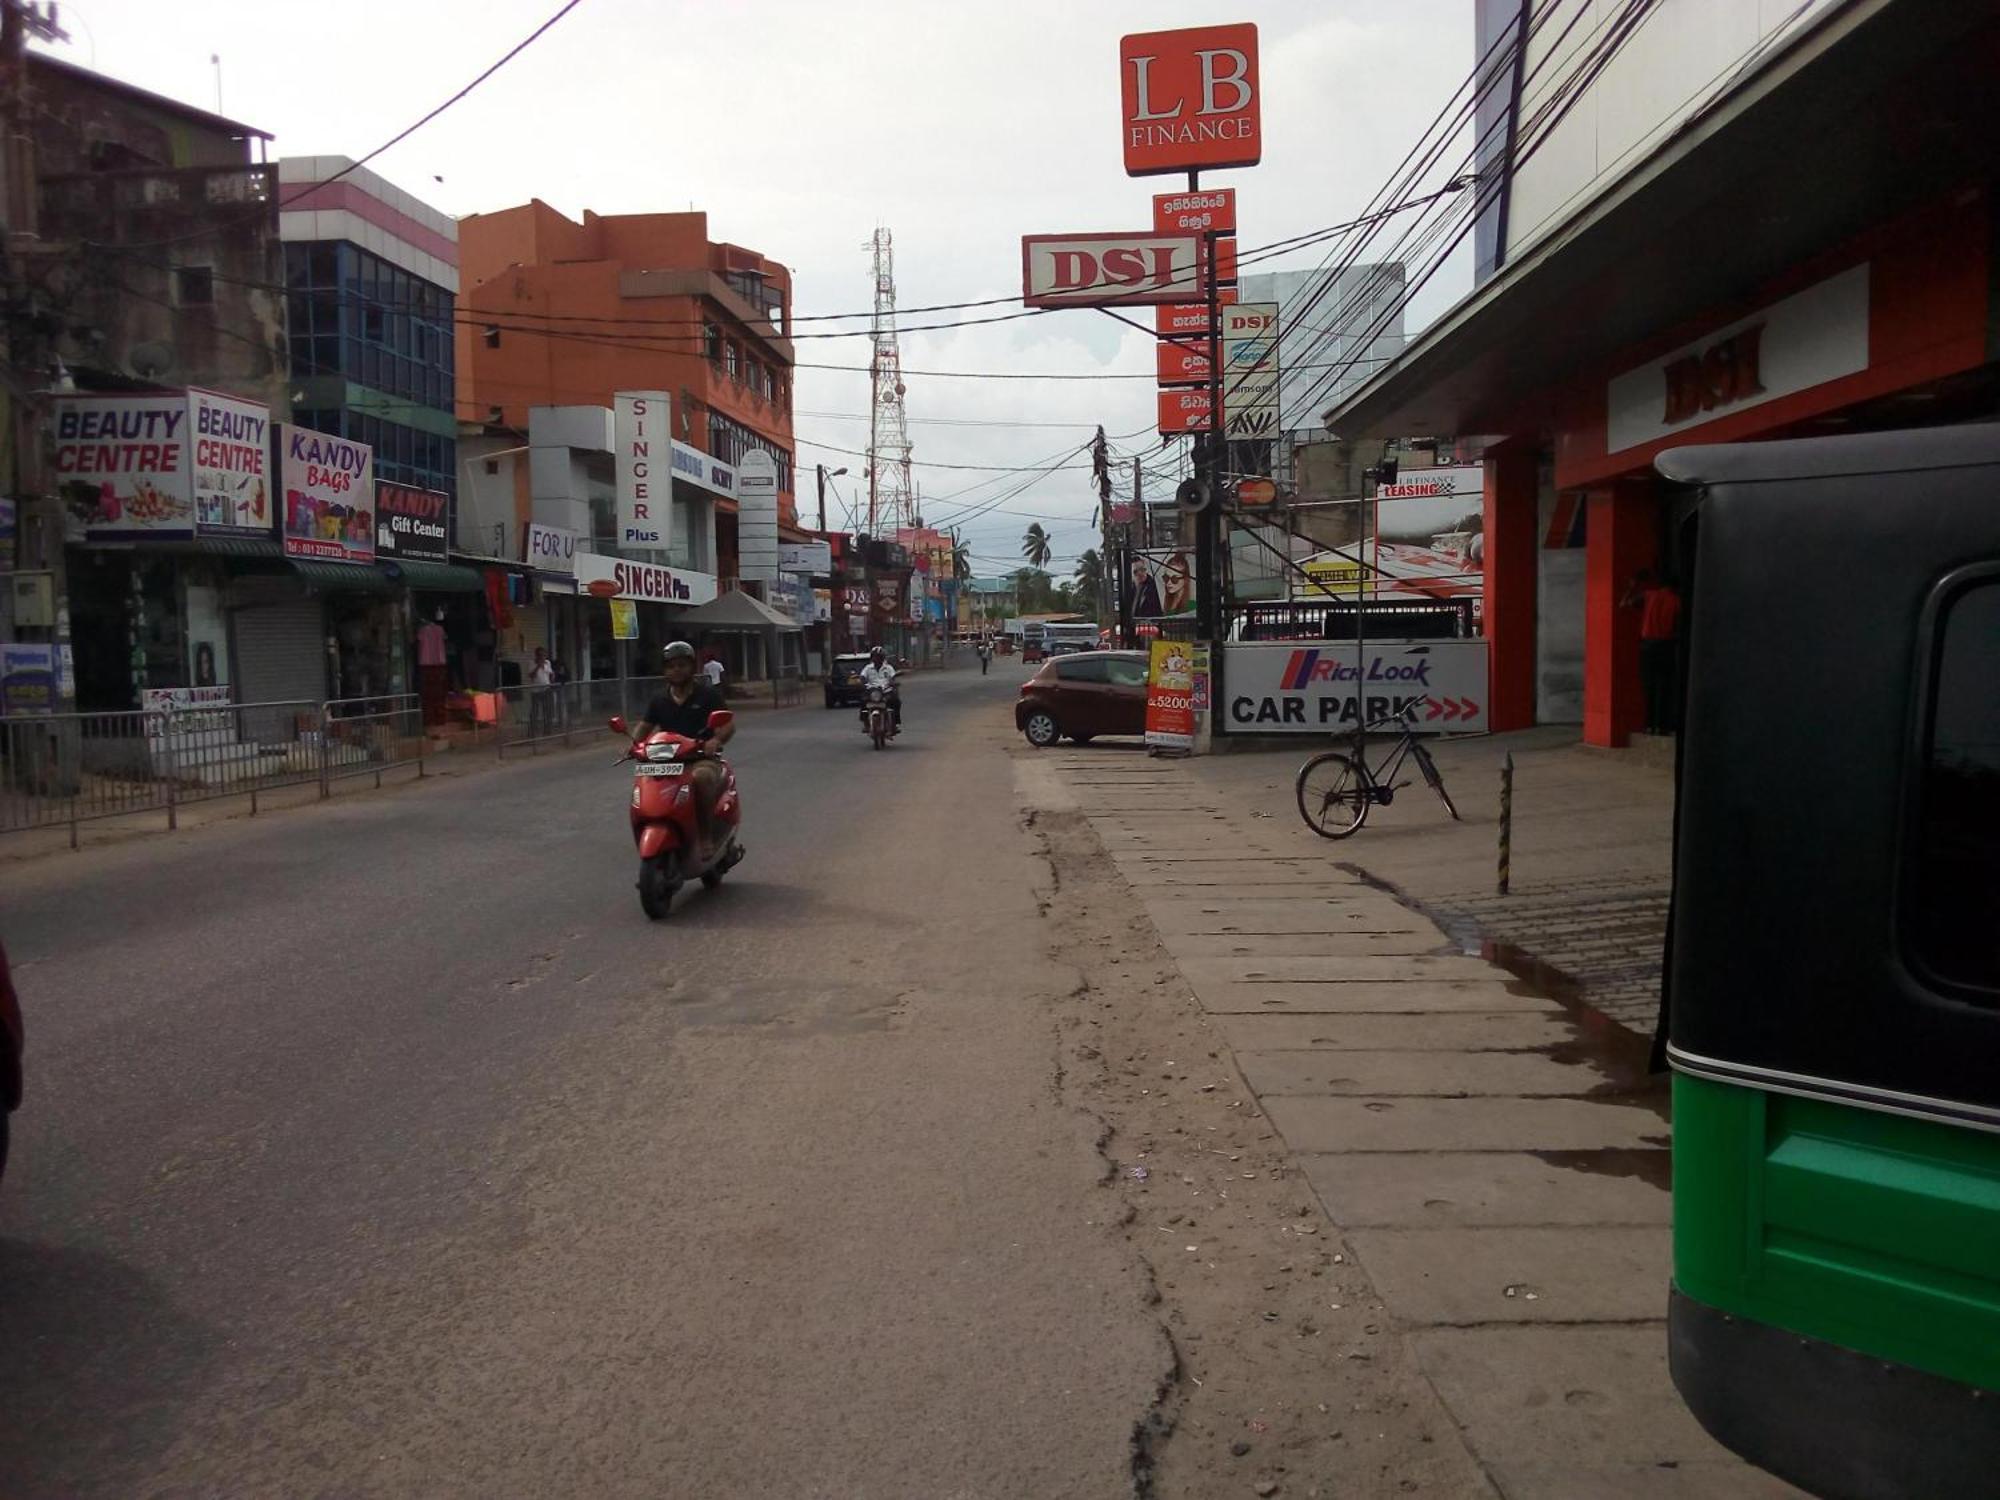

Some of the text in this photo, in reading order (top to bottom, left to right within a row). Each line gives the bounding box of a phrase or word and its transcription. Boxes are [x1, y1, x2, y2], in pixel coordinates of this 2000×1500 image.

[1131, 117, 1253, 149] FINANCE
[1050, 246, 1180, 290] DSI
[1231, 316, 1272, 330] DSI
[58, 409, 184, 440] BEAUTY
[198, 406, 265, 442] BEAUTY
[57, 443, 181, 475] CENTRE
[196, 441, 264, 475] CENTRE
[289, 433, 368, 480] KANDY
[632, 399, 649, 520] SINGER
[306, 465, 352, 493] BAGS
[1385, 483, 1440, 497] LEASING
[378, 486, 446, 519] KANDY
[391, 515, 445, 538] Gift Center
[625, 528, 660, 543] Plus
[532, 529, 575, 560] FOR U
[614, 562, 673, 599] SINGER
[1231, 696, 1306, 724] CAR
[1318, 695, 1421, 724] PARK
